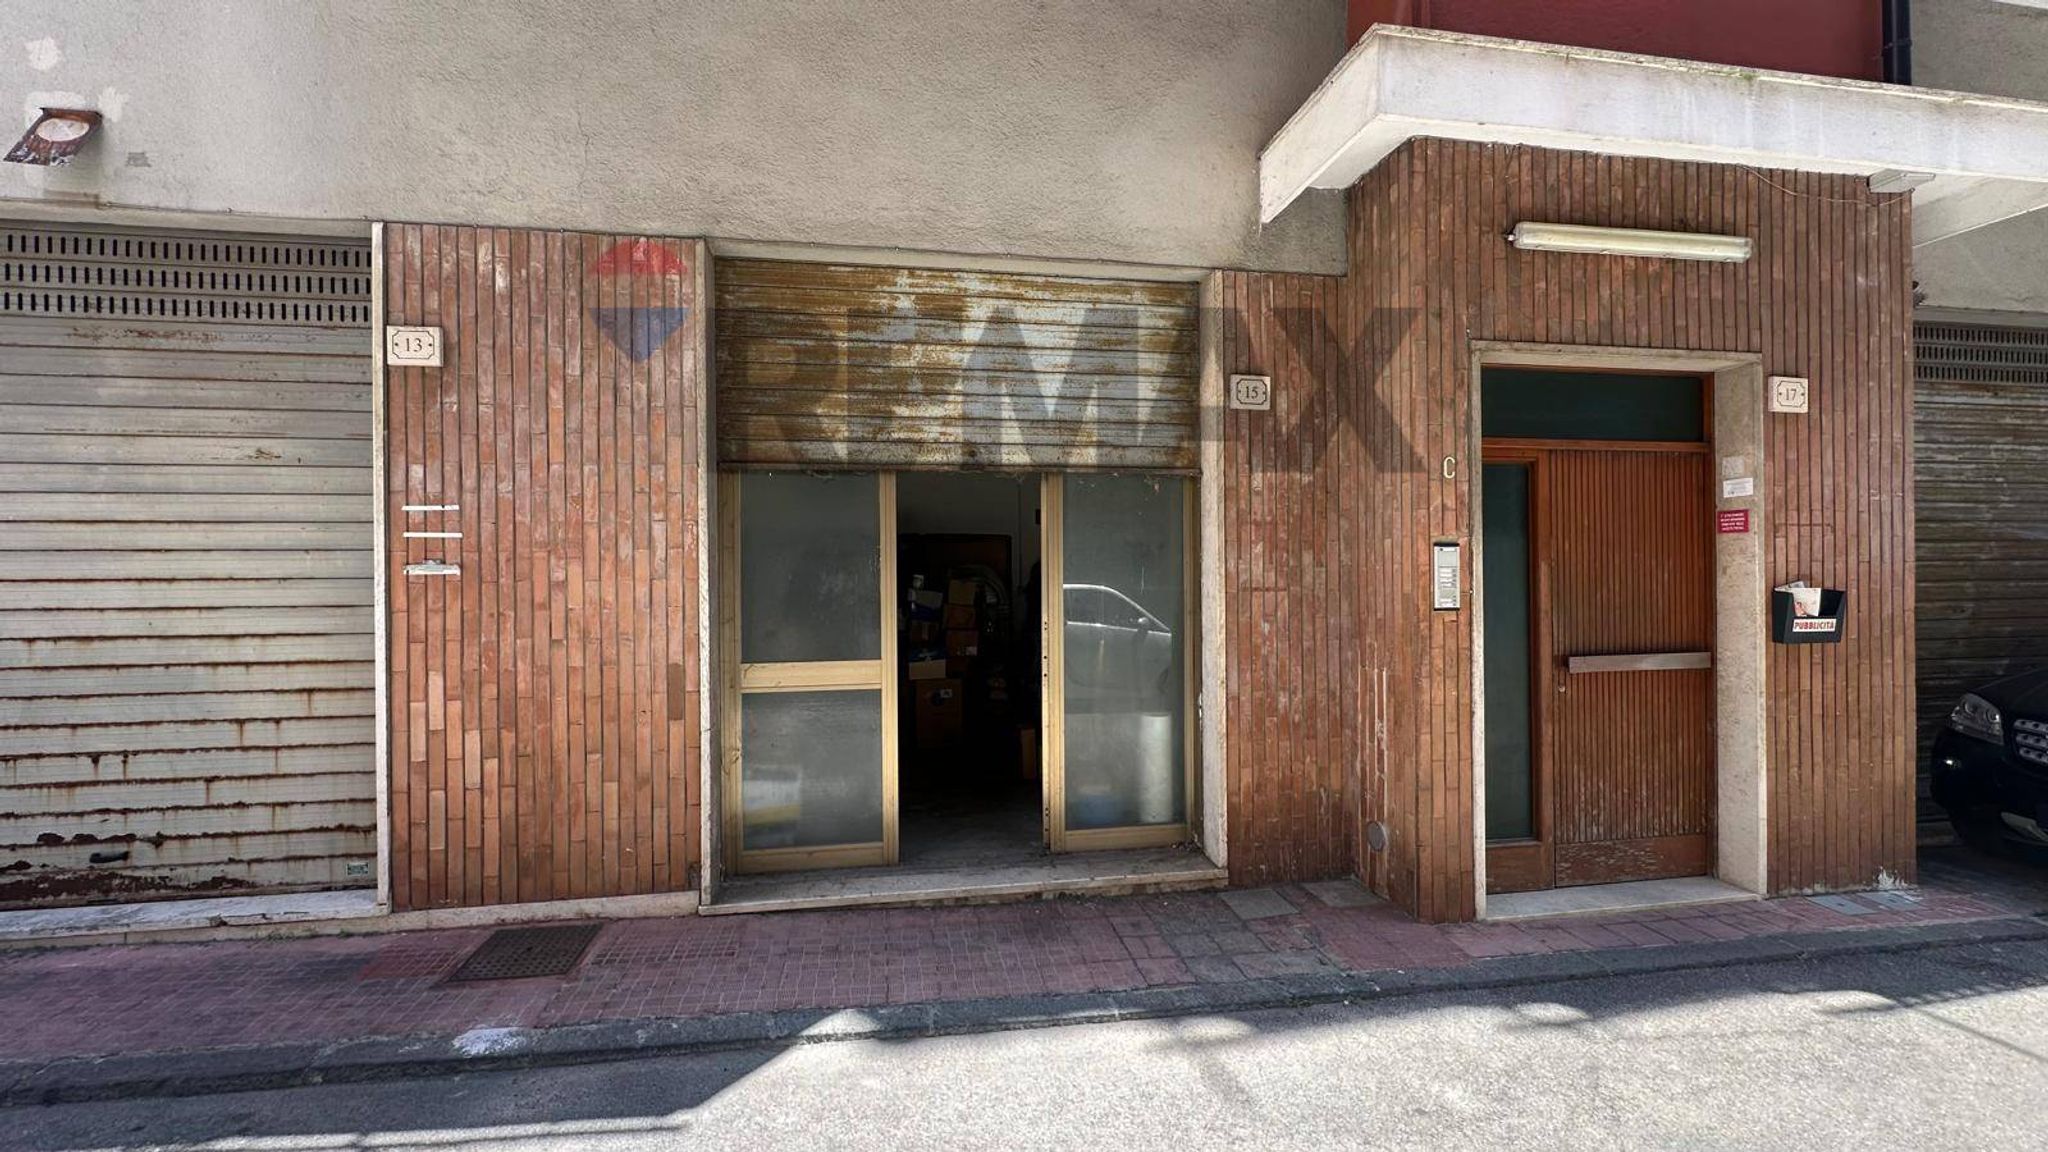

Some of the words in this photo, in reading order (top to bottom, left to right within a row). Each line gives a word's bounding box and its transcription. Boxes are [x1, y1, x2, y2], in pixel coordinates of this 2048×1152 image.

[405, 337, 424, 352] 13
[1246, 386, 1260, 400] 15
[1785, 387, 1798, 401] 17
[1443, 456, 1455, 478] C
